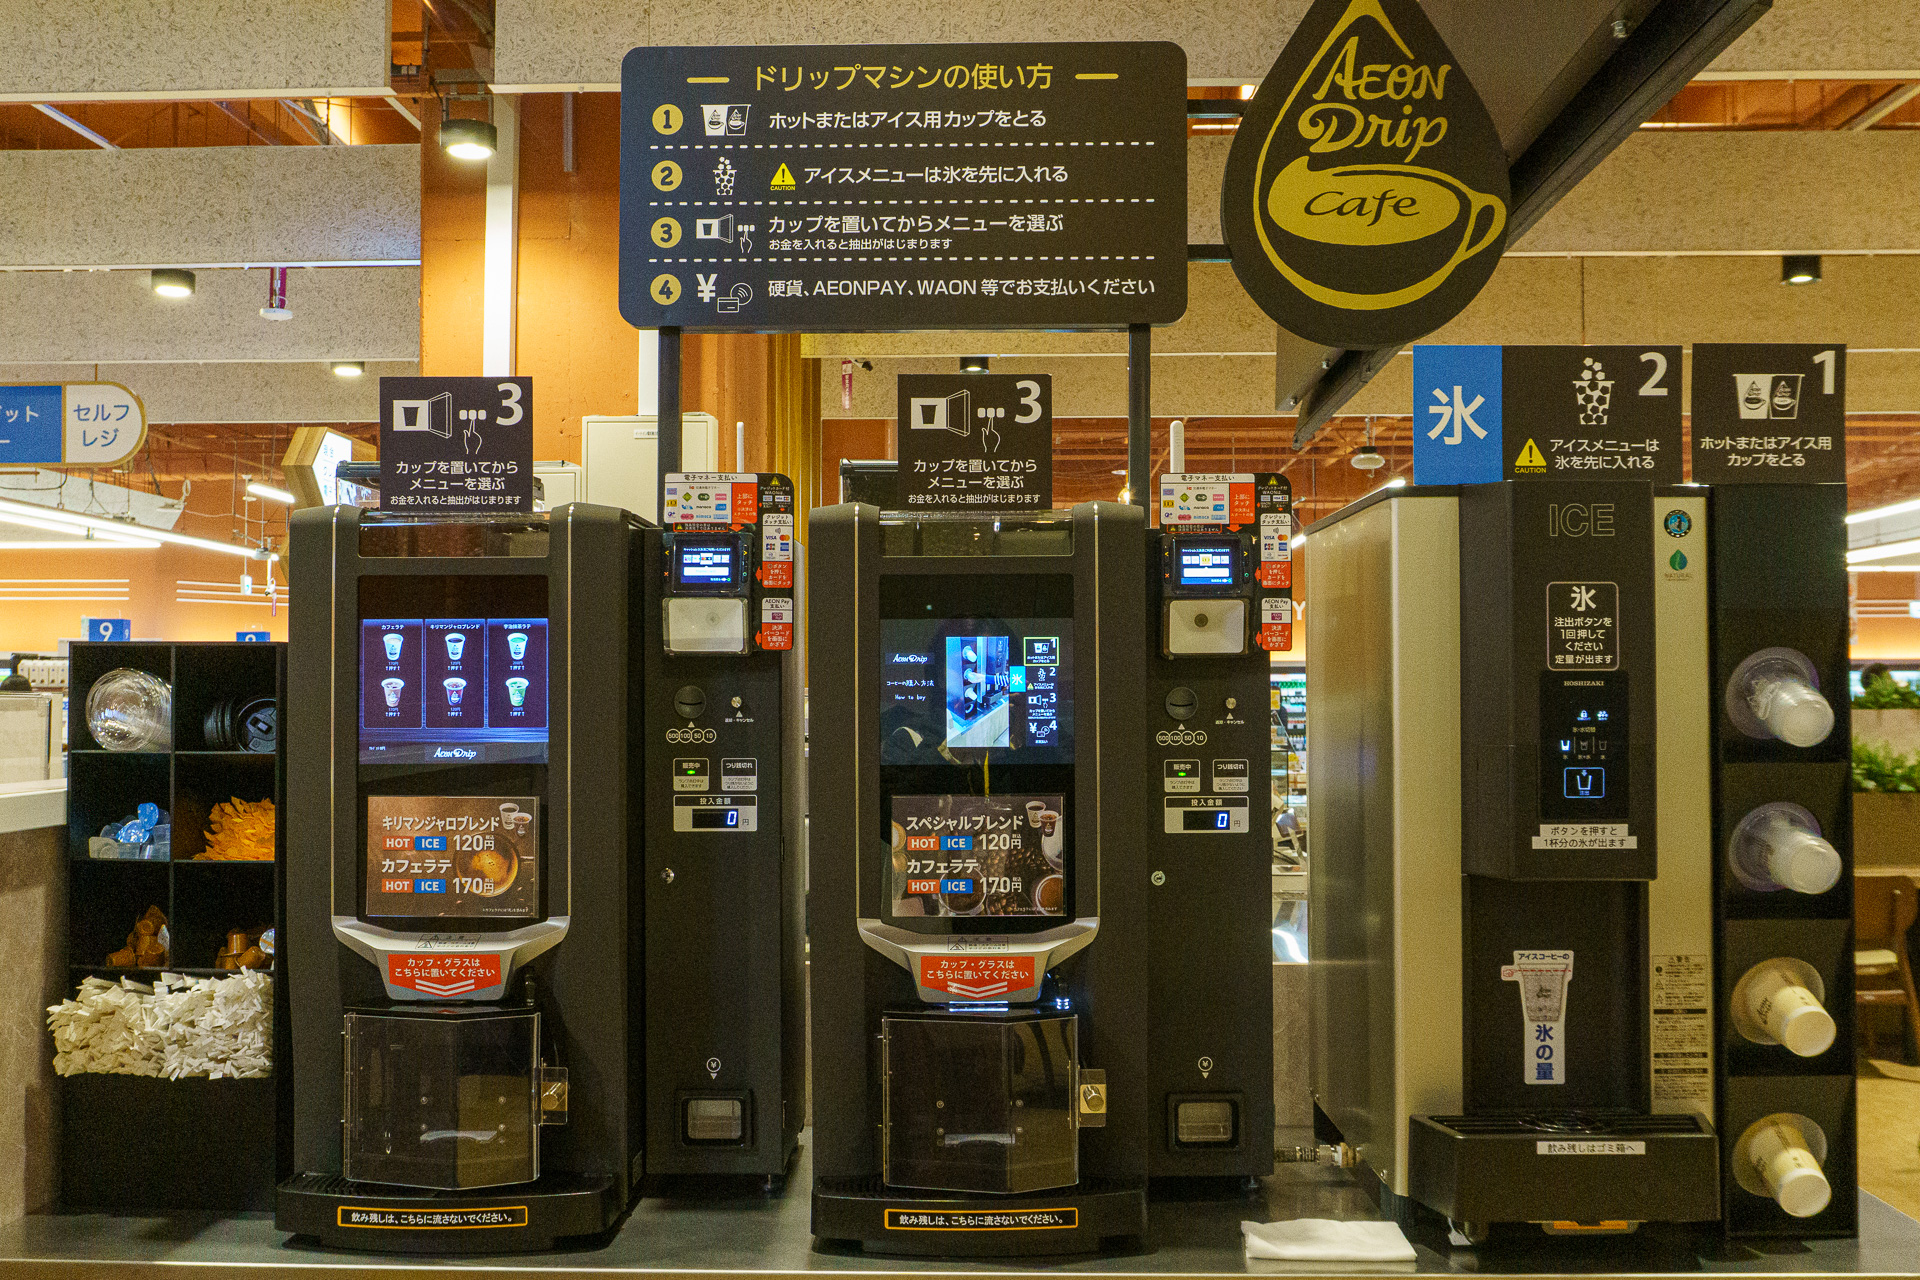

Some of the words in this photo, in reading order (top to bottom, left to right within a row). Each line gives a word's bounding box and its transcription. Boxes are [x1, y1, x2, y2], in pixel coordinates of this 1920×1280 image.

[755, 63, 1053, 91] ドリップマシンの使い方
[769, 110, 1046, 129] ホットまたはアイス用カップをとる
[1298, 102, 1448, 163] Drip
[804, 165, 1068, 184] アイスメニューは氷を先に入れる
[768, 214, 1064, 234] カップを置いてからメニューを選ぶ
[768, 238, 952, 250] お金を入れると抽出がはじまります
[1638, 351, 1668, 396] 2
[1812, 350, 1836, 395] 1
[495, 382, 524, 426] 3
[1014, 380, 1043, 424] 3
[73, 404, 129, 422] セルフ
[1427, 385, 1488, 445] 氷
[82, 429, 119, 448] レジ
[1550, 438, 1659, 452] アイスメニューは
[1700, 436, 1832, 450] ホットまたはアイス用
[913, 459, 1037, 473] カップを置いてから
[1554, 455, 1655, 470] 氷を先に入れる
[1727, 453, 1806, 467] カップをとる
[395, 461, 519, 475] カップを置いてから
[409, 477, 505, 491] メニューを選ぶ
[927, 475, 1024, 489] メニューを選ぶ
[390, 495, 522, 505] お金を入れると抽出がはじまります
[908, 494, 1041, 504] お金を入れると抽出がはじまります
[1550, 503, 1616, 537] ICE
[1570, 585, 1597, 611] 氷
[1554, 617, 1612, 627] 注出ボタンを
[1560, 629, 1605, 639] 1回押して
[1565, 641, 1603, 651] ください
[1555, 654, 1613, 664] 定量が出ます
[700, 797, 731, 805] 投入金額
[1191, 798, 1222, 806] 投入金額
[382, 815, 500, 831] キリマンジャロブレンド
[905, 815, 1024, 831] スペシャルブレンド
[1550, 826, 1617, 836] ボタンを押すと
[386, 839, 410, 848] HOT
[421, 838, 439, 848] ICE
[911, 839, 935, 848] HOT
[947, 838, 965, 848] ICE
[1544, 838, 1626, 848] 1杯分の氷が出ます
[381, 858, 452, 874] カフェラテ
[906, 858, 979, 874] カフェラテ
[385, 881, 410, 891] HOT
[421, 881, 439, 891] ICE
[911, 881, 936, 891] HOT
[947, 881, 966, 891] ICE
[407, 958, 480, 967] カップ・グラスは
[940, 960, 1014, 969] カップ・グラスは
[394, 967, 495, 978] こちらに置いてください
[926, 970, 1029, 980] こちらに置いてください
[1535, 1024, 1554, 1081] 氷の量
[1547, 1143, 1635, 1154] 飲み残しはゴミ箱へ
[351, 1212, 512, 1225] 飲み残しは、こちらに流さないでください。
[899, 1213, 1064, 1226] 飲み残しは、こちらに流さないでください。
